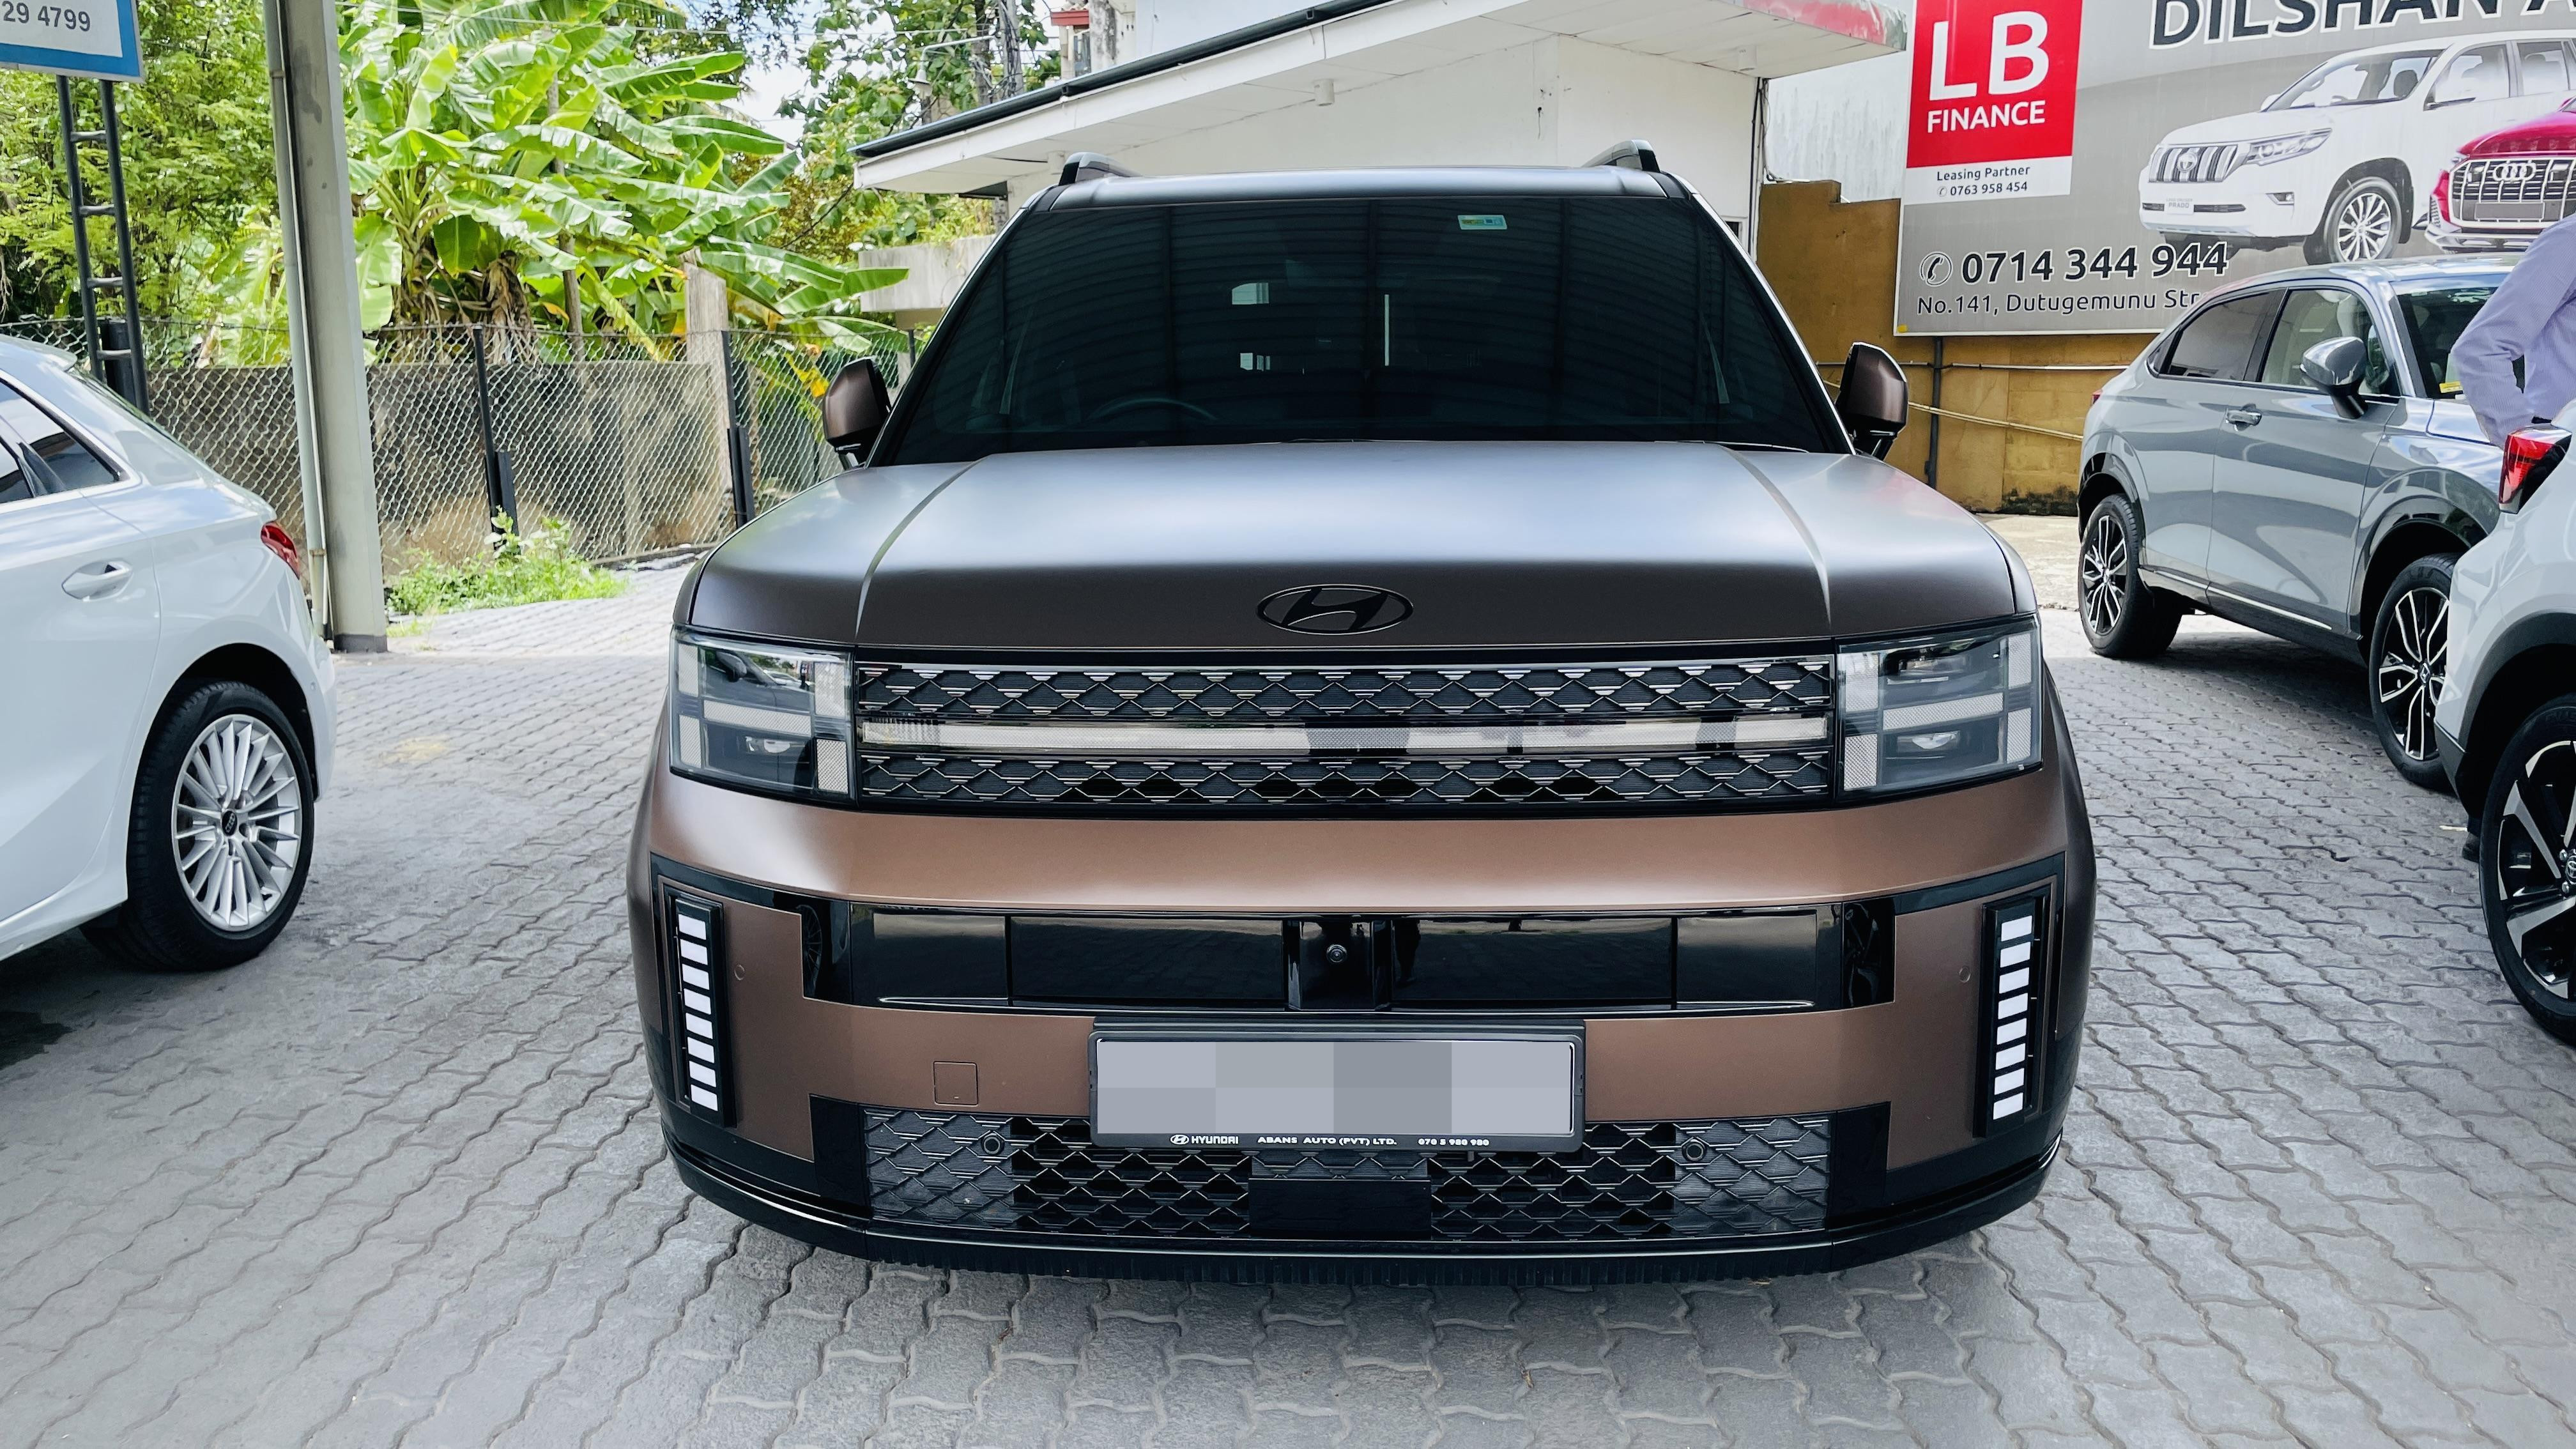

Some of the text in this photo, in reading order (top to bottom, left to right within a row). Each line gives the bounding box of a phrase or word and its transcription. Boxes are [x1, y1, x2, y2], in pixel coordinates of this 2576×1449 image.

[2, 0, 91, 32] 29 4799
[2150, 0, 2499, 47] DILSH
[1929, 11, 2050, 101] LB
[1928, 100, 2046, 134] FINANCE
[1937, 166, 2030, 181] Leasing Partner
[1950, 181, 2028, 196] 0763 958 454
[1962, 241, 2228, 283] 0714 344 944
[1918, 289, 2202, 316] No.141, Dutugemunu Str
[1191, 1135, 1239, 1144] HYUNDAI
